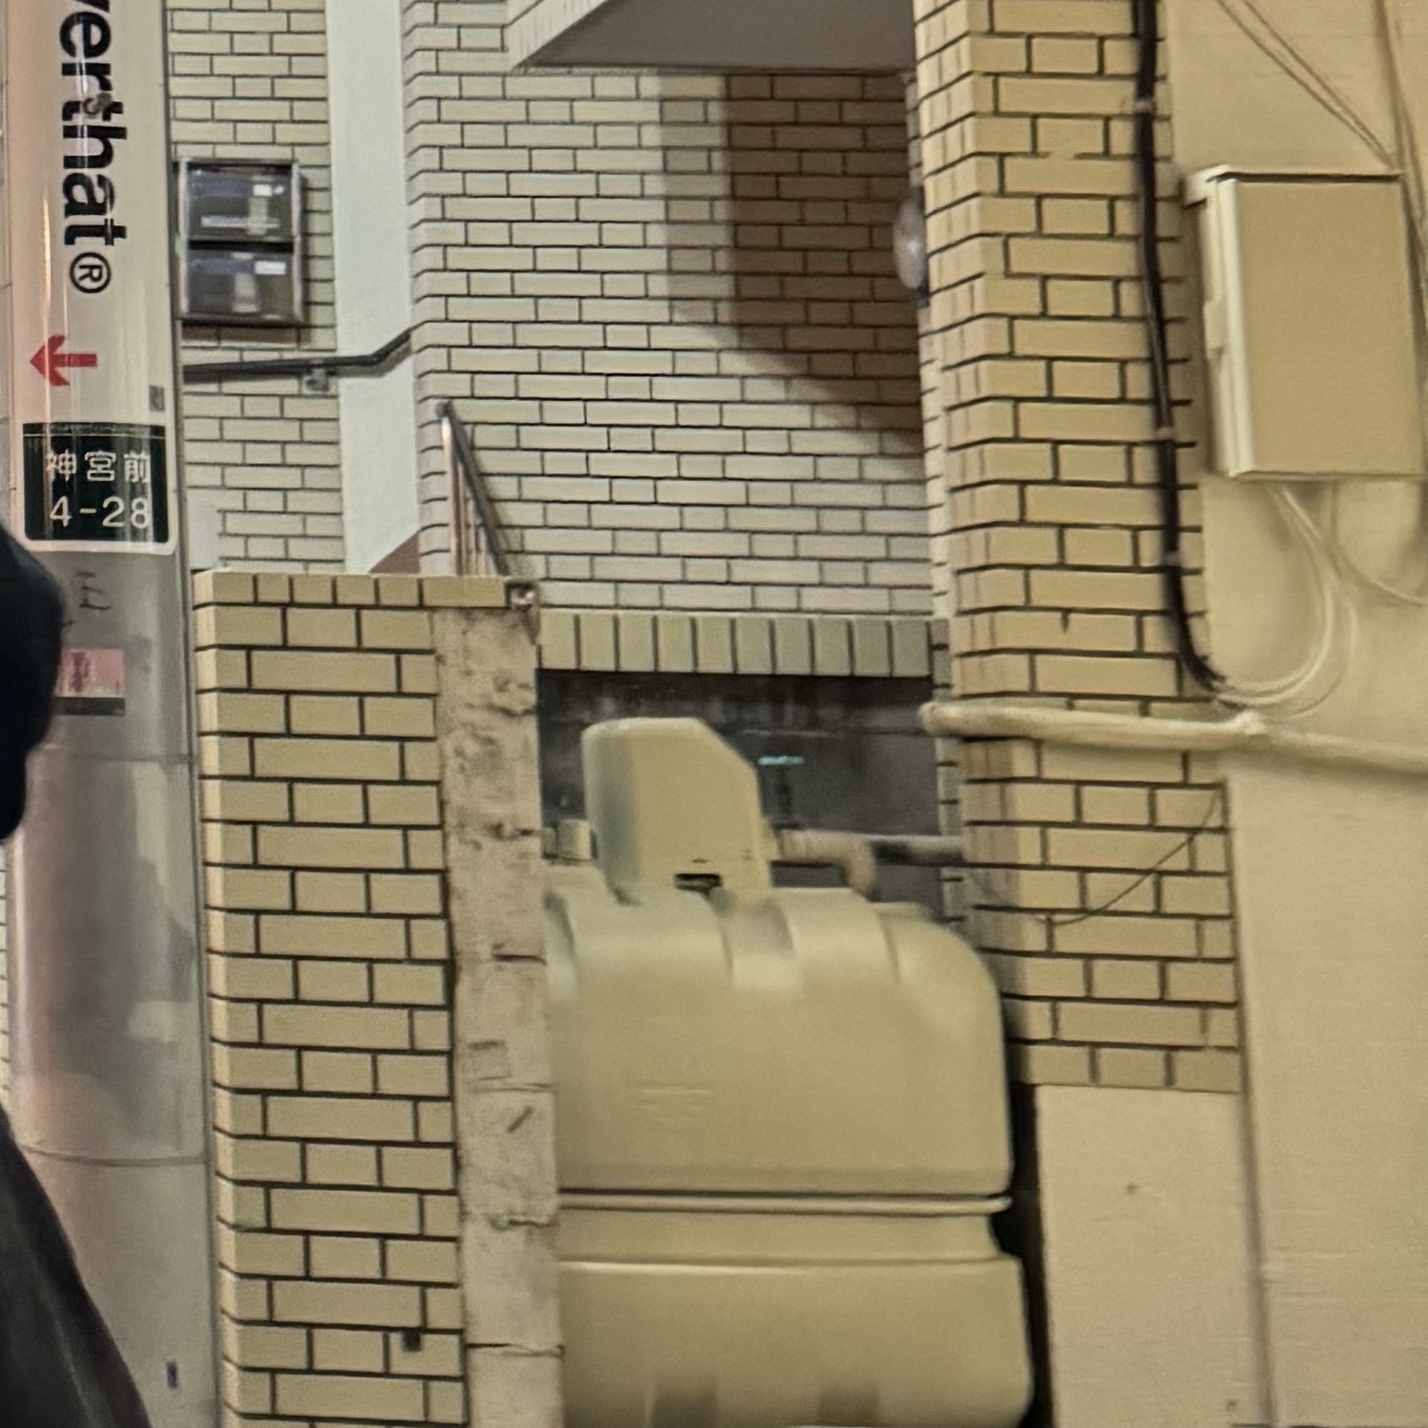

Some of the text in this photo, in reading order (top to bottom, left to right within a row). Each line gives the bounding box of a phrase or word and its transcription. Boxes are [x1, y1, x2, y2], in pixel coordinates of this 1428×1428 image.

[45, 448, 151, 484] 神宮前
[48, 495, 149, 529] 4-28
